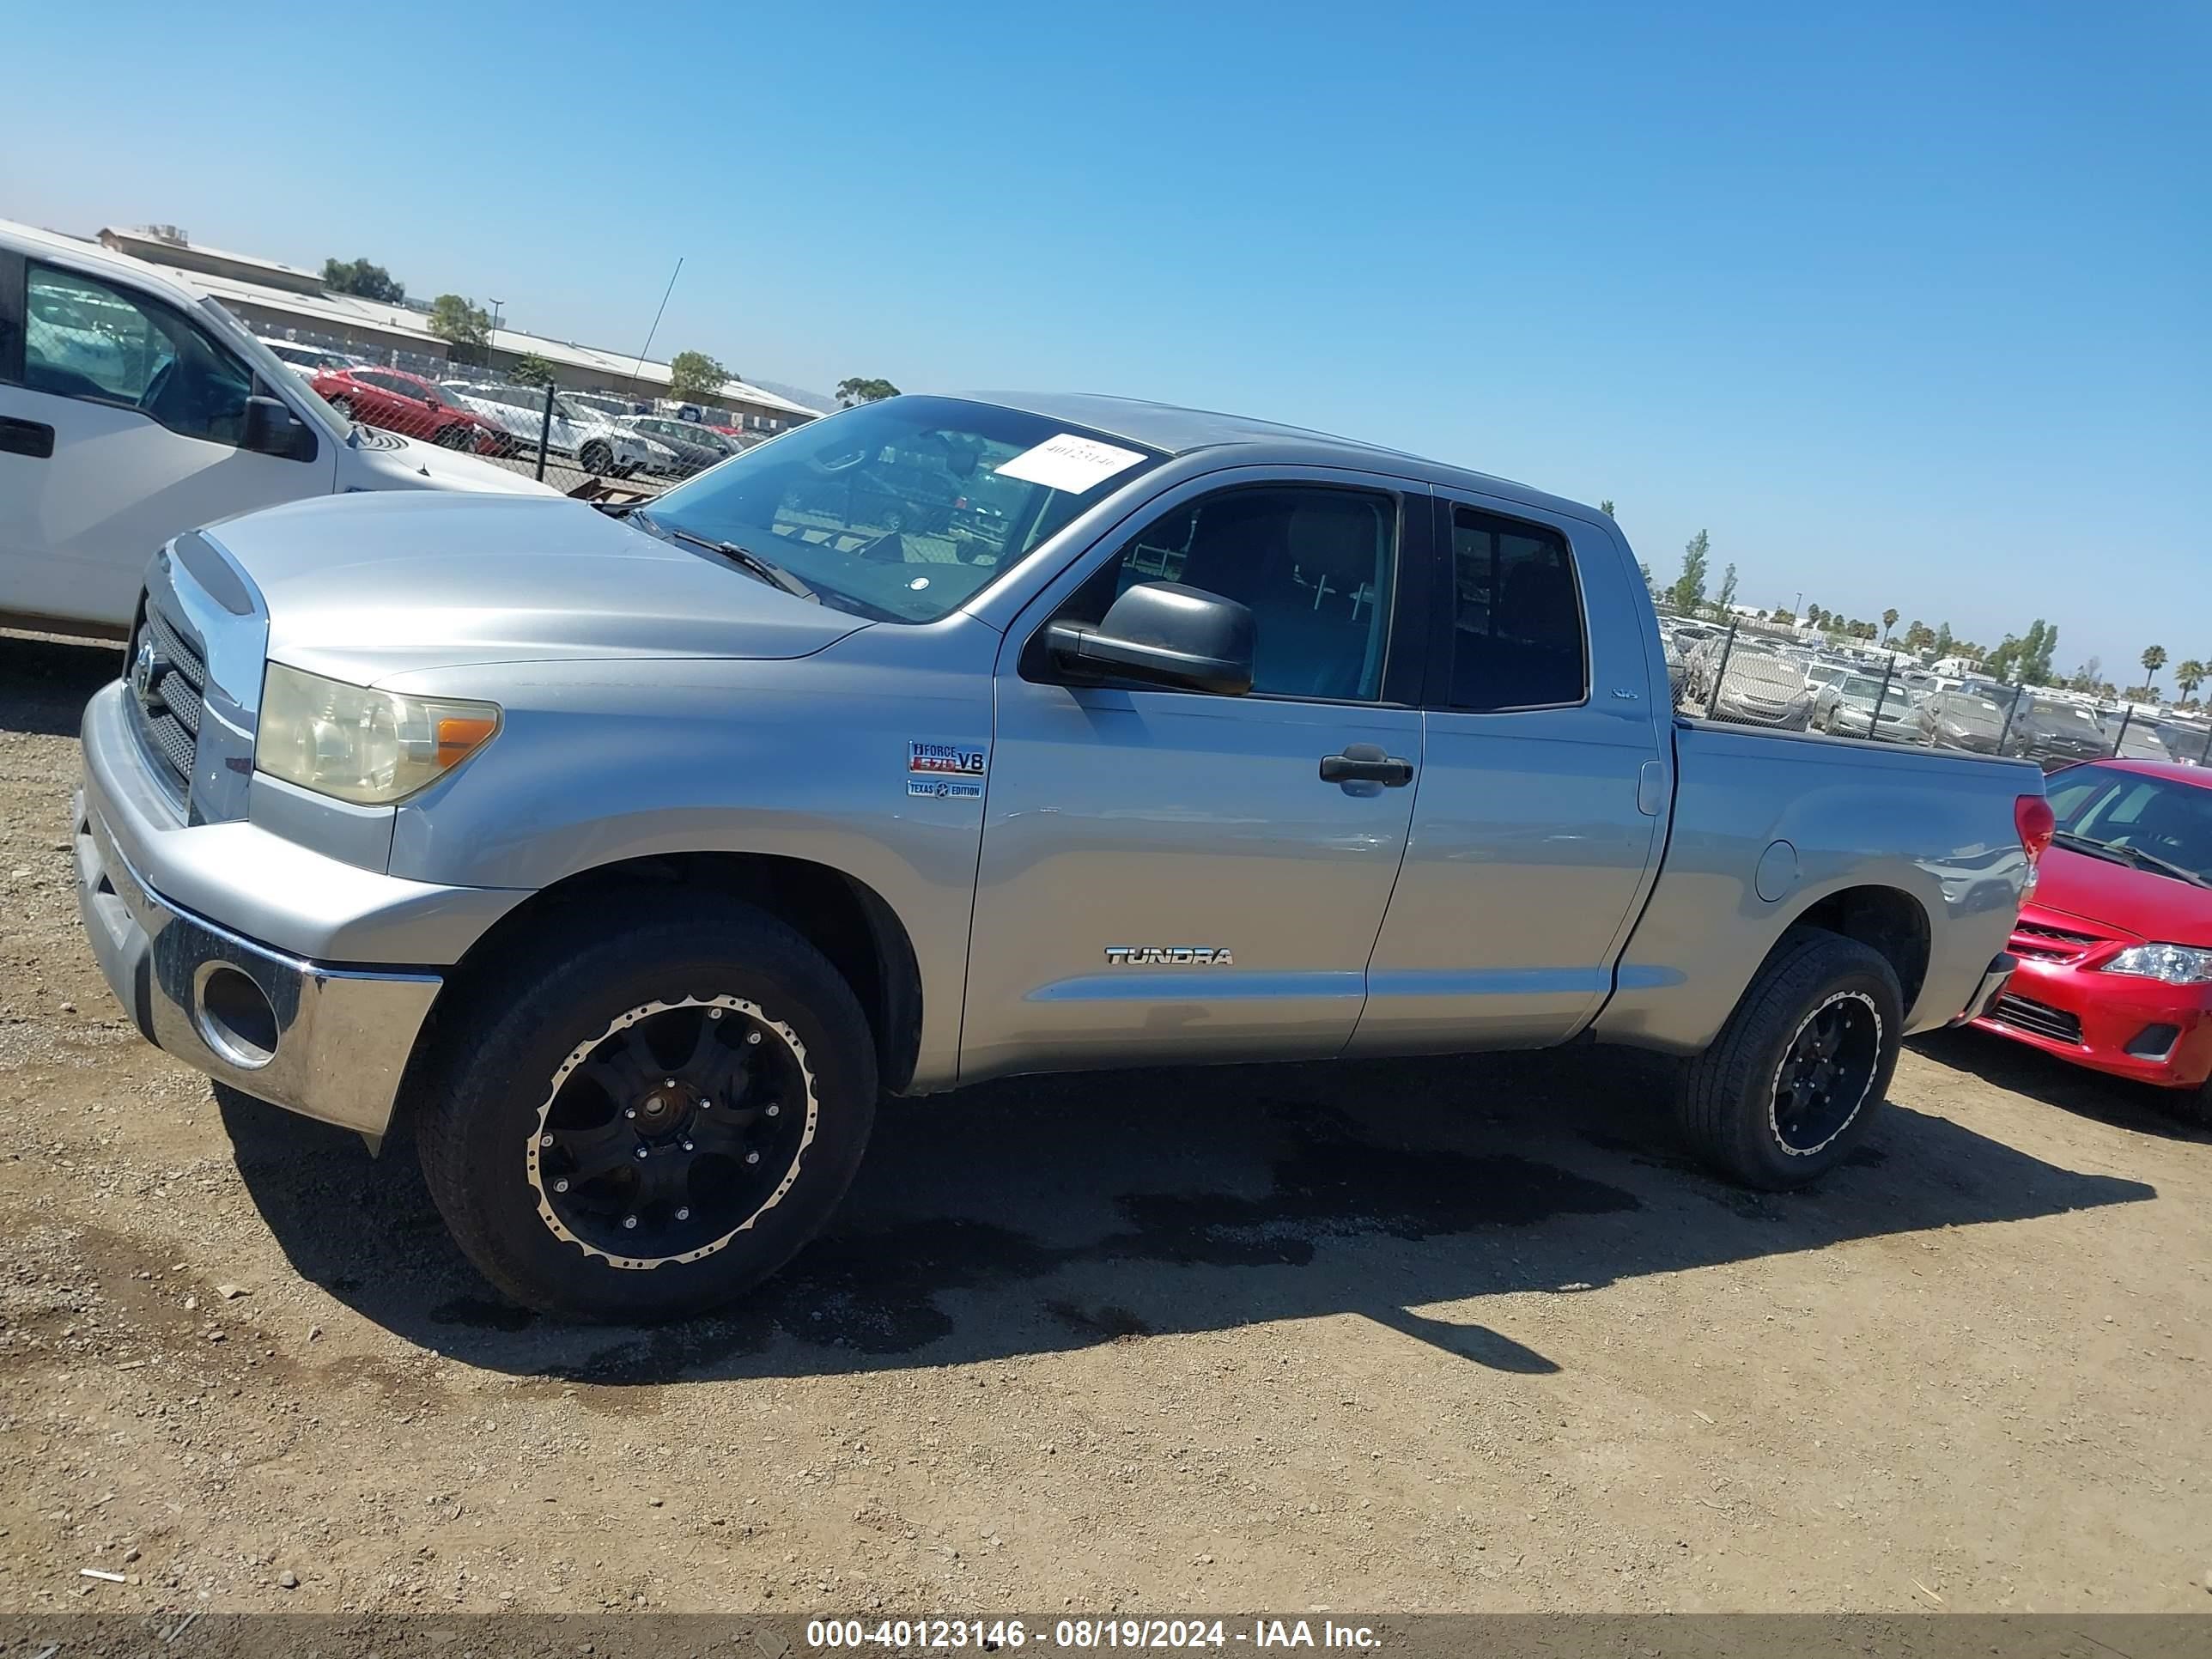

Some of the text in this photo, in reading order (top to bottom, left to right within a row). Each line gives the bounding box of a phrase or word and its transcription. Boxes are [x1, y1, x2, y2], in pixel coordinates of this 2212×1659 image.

[957, 752, 983, 770] V8
[910, 784, 980, 795] TEXAS EDITION
[1105, 947, 1234, 965] TUNDRA
